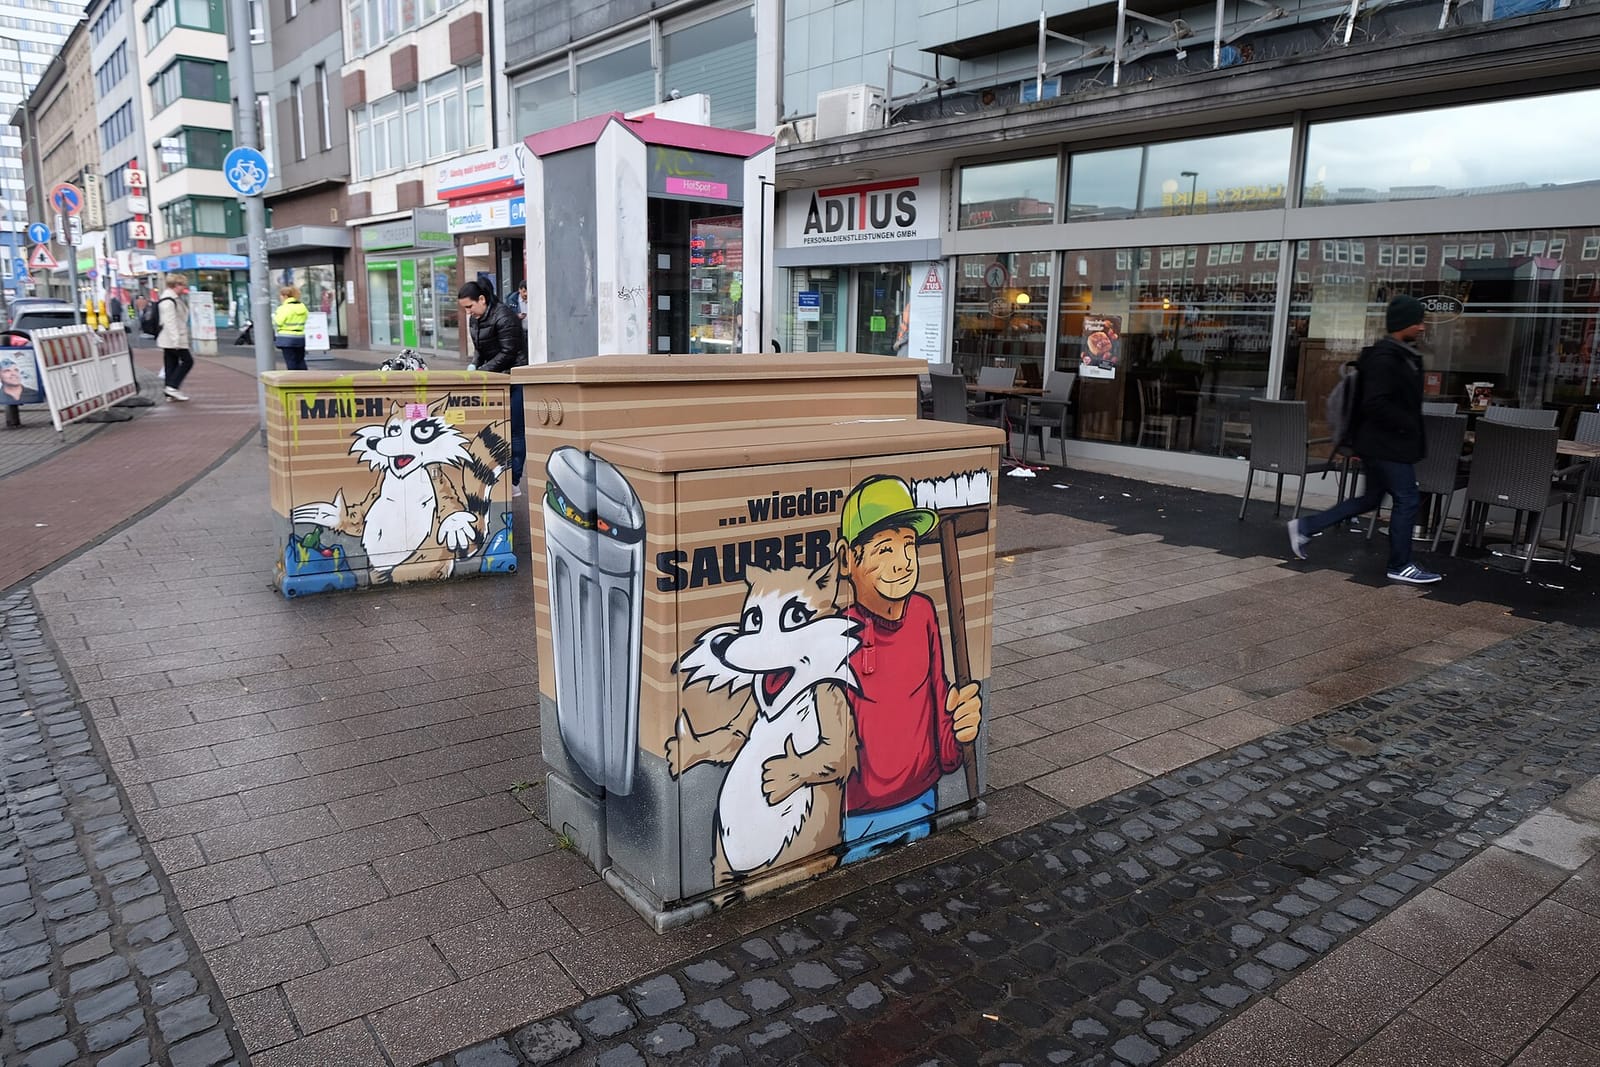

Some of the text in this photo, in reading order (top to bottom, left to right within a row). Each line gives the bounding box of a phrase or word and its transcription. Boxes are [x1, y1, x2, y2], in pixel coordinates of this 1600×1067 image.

[683, 180, 711, 192] HotSpot
[449, 210, 482, 228] Lycamobile
[804, 177, 919, 235] ADITUS
[803, 230, 917, 245] PERSONALDIENSTLEISTUNGEN GMBH
[718, 486, 843, 527] ...wieder
[656, 527, 843, 593] SAUBER
